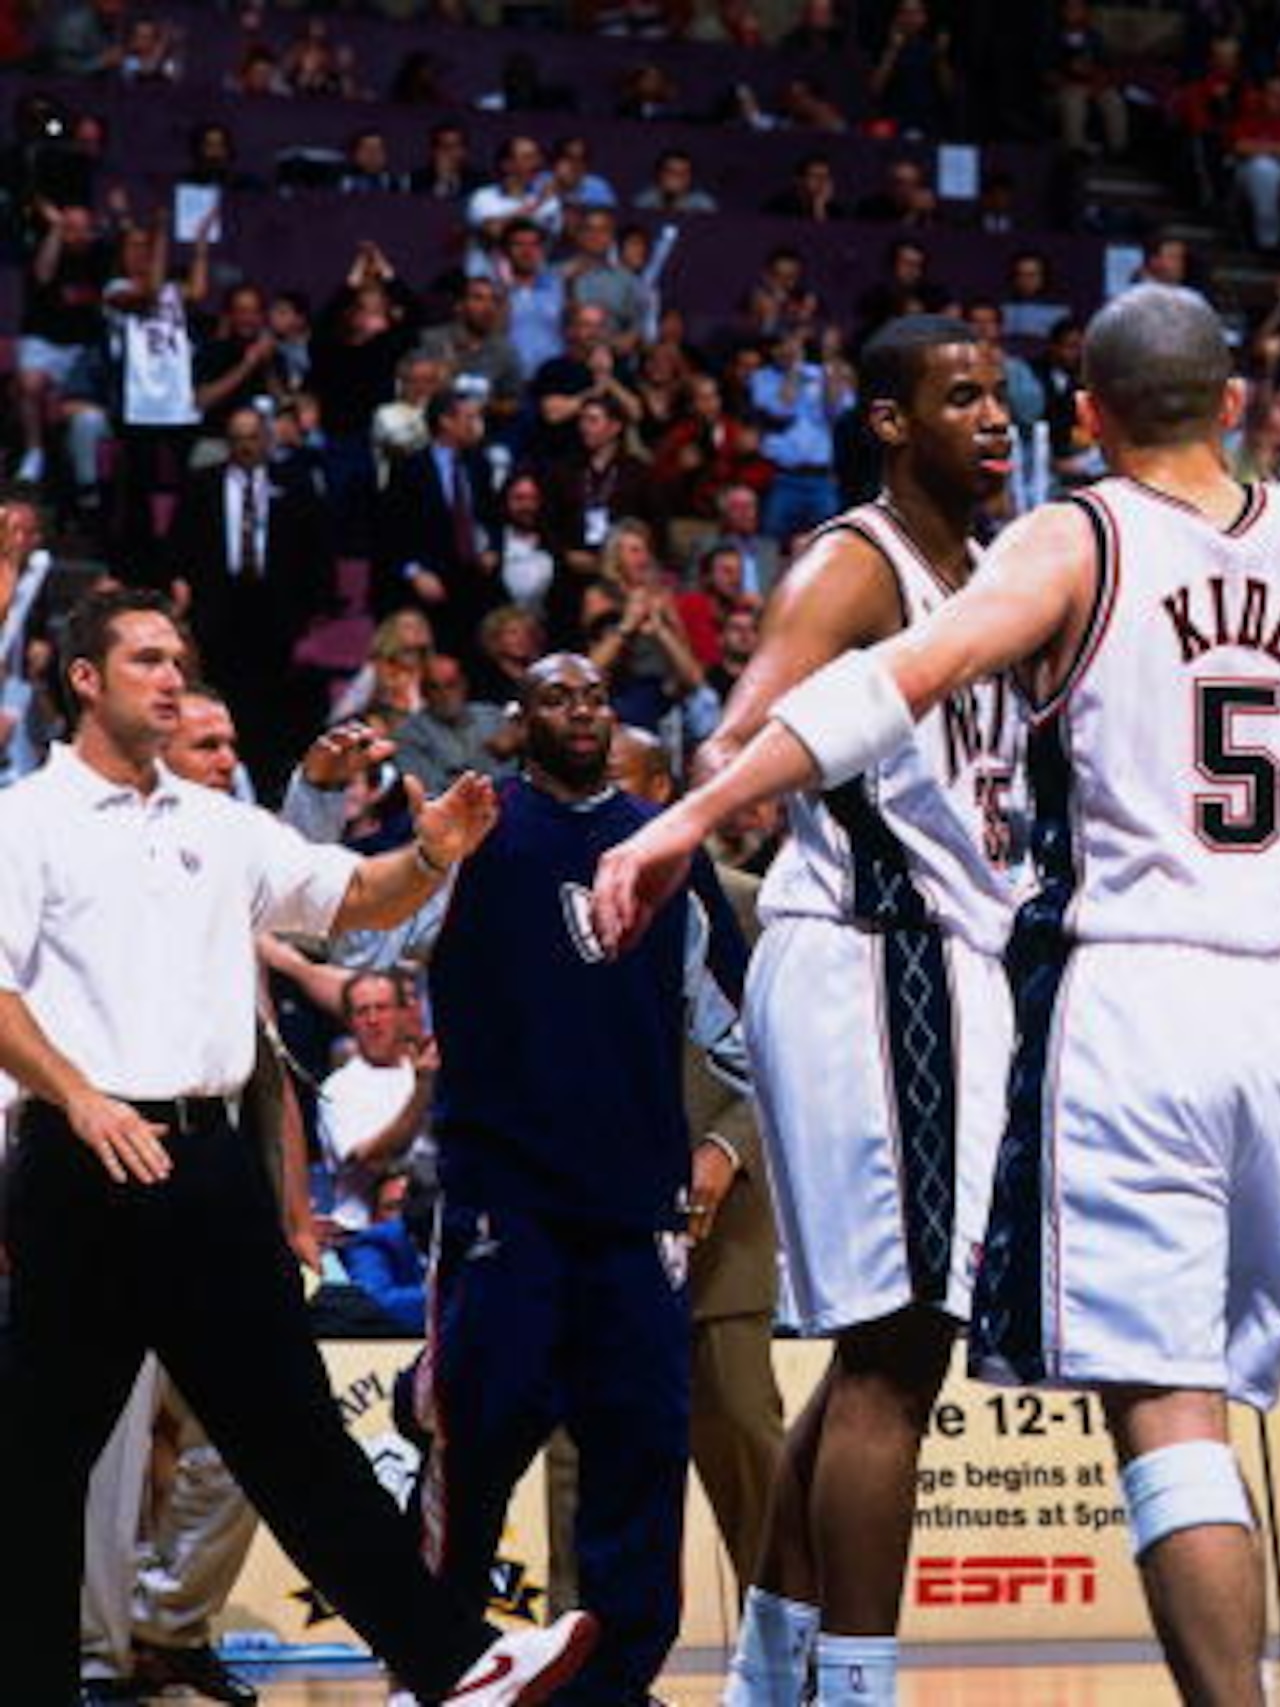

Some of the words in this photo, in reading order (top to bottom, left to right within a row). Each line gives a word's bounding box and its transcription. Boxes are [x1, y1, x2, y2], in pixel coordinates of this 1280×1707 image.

[986, 1393, 1093, 1436] 12-1
[965, 1462, 1066, 1492] begins
[1077, 1463, 1105, 1487] at
[914, 1504, 1027, 1527] ntinues
[1038, 1504, 1067, 1527] at
[916, 1556, 1095, 1605] ESPN
